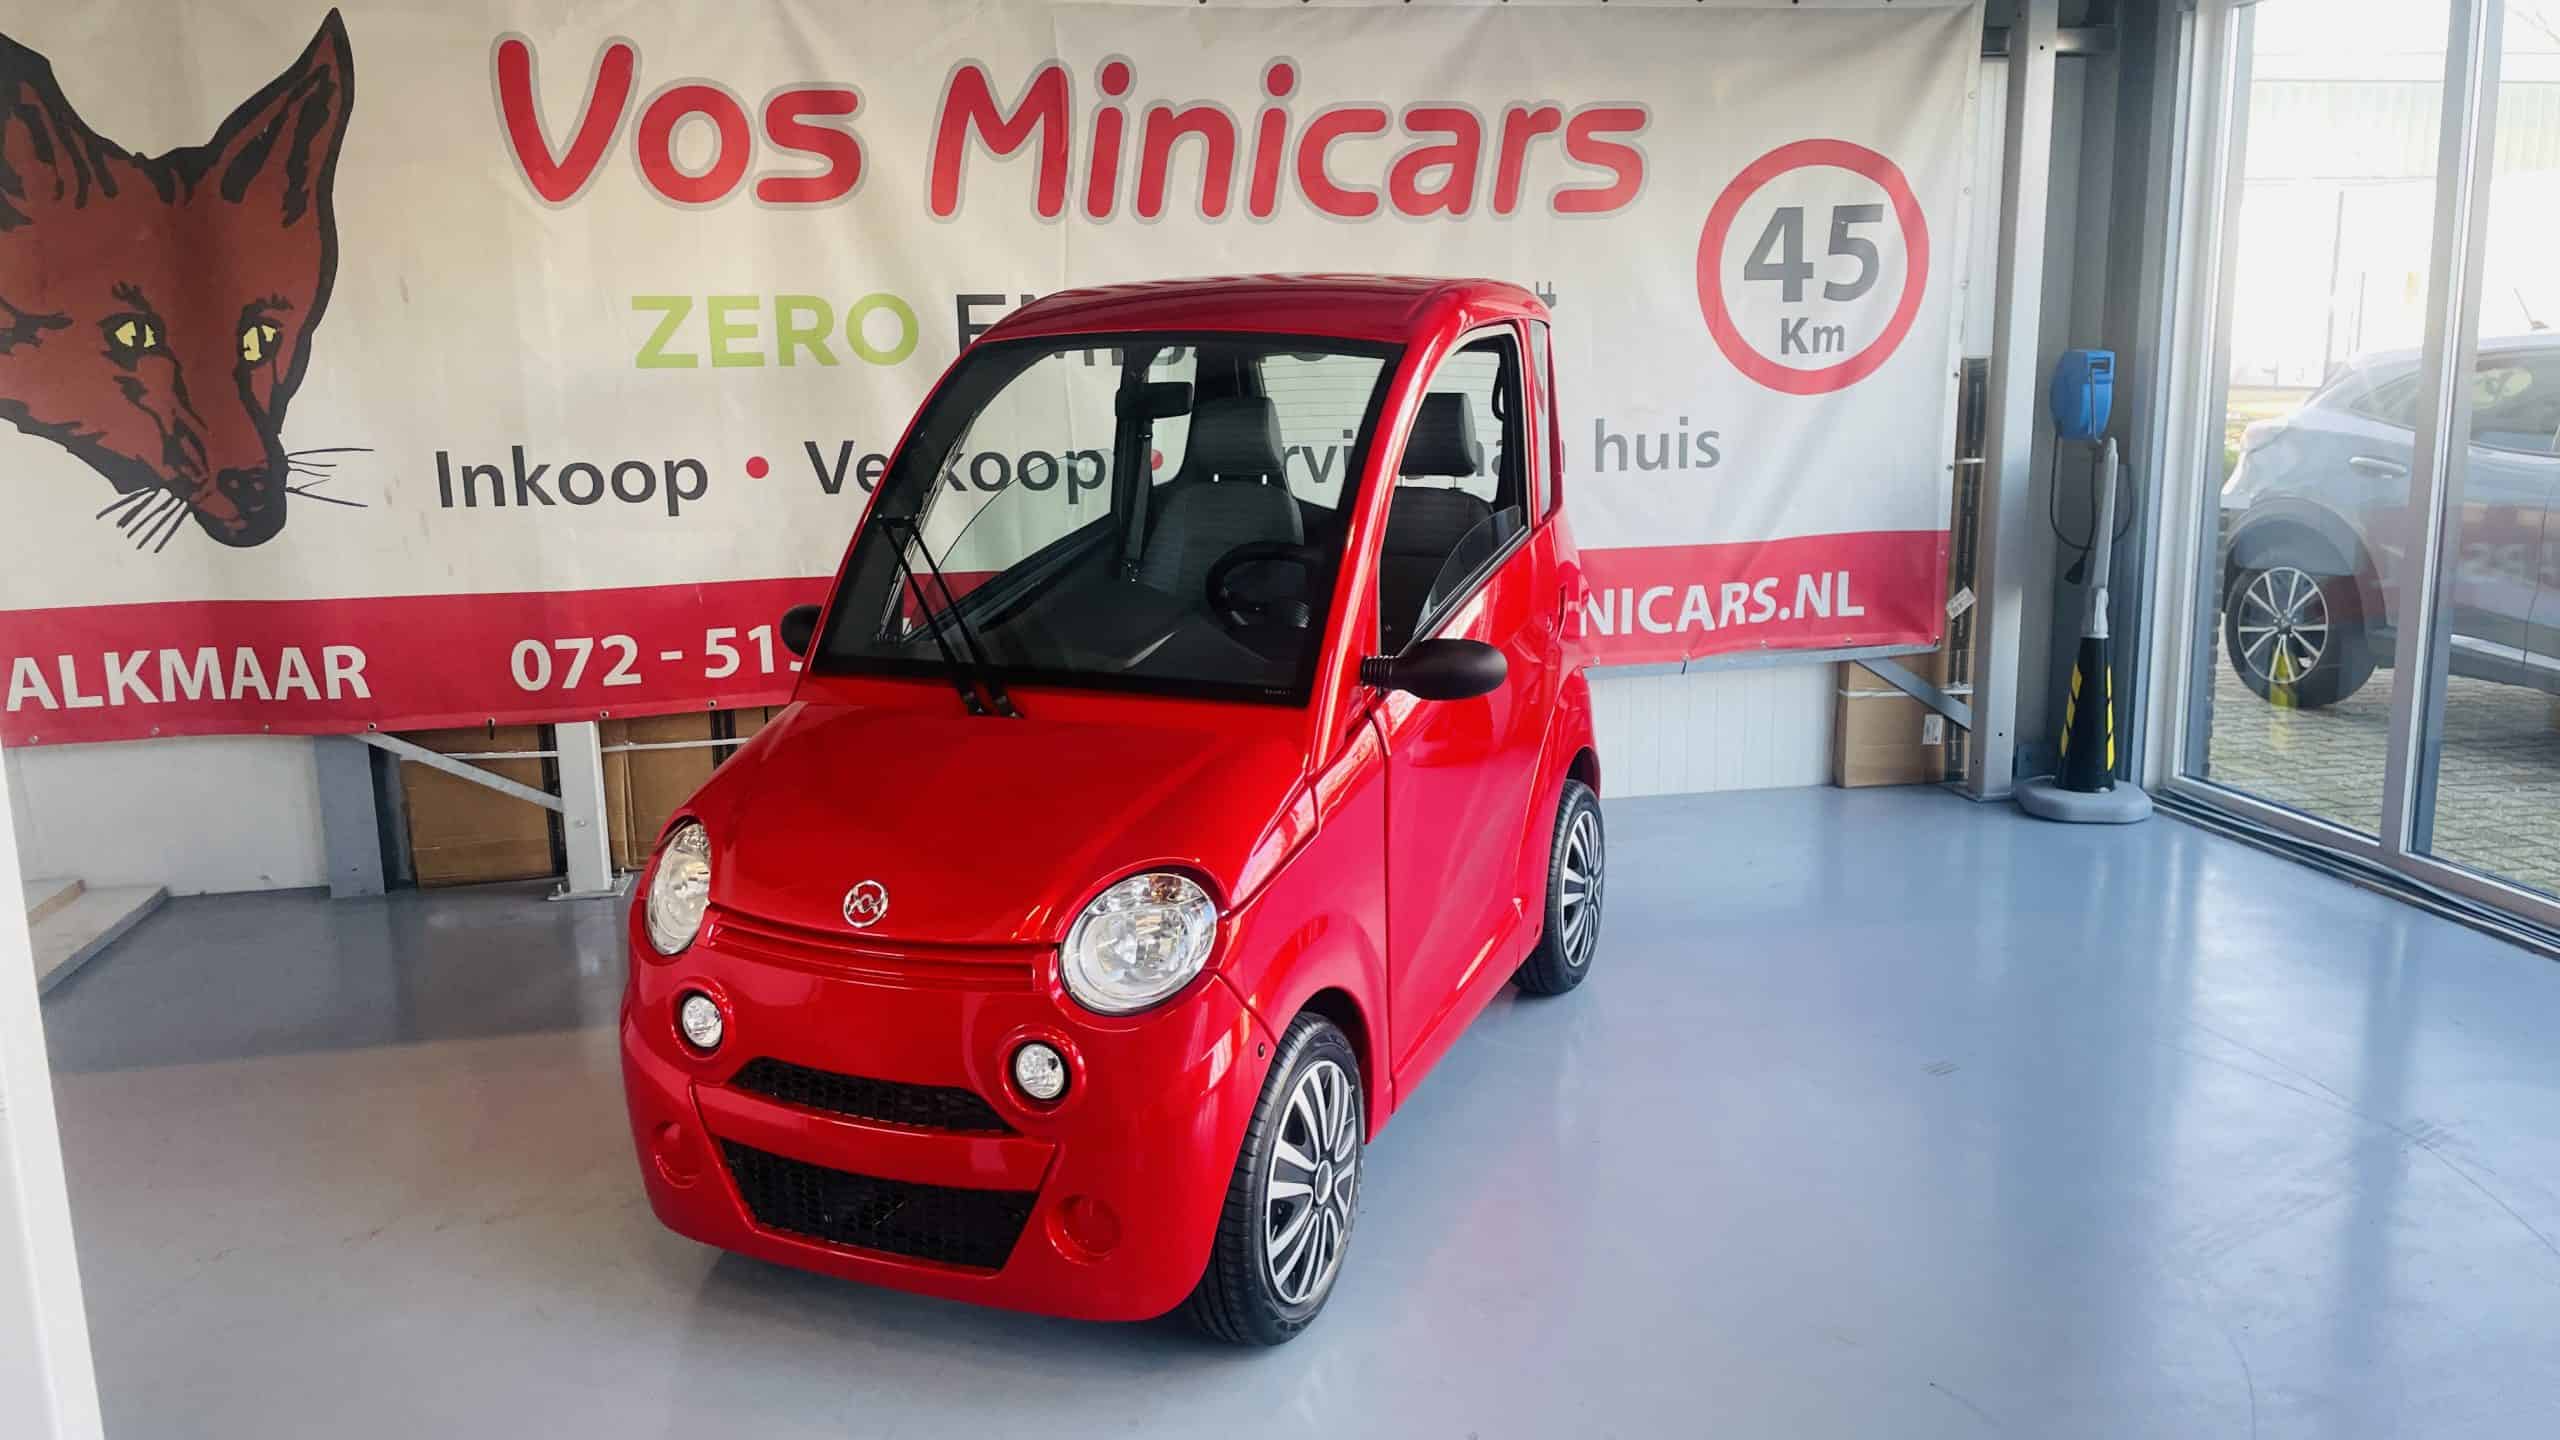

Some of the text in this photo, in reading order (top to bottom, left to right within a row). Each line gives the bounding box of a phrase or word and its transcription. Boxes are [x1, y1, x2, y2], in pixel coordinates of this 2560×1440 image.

[493, 35, 1650, 222] Vos Minicars
[1744, 205, 1884, 303] 45
[632, 293, 918, 369] ZERO
[1781, 317, 1846, 355] Km
[436, 445, 708, 517] Inkoop
[804, 439, 1106, 506] Veoop
[1594, 416, 1721, 473] huis
[1578, 570, 1866, 637] NICARS.NL
[6, 645, 372, 712] ALKMAAR
[510, 634, 642, 692] 072
[704, 624, 803, 679] 51
